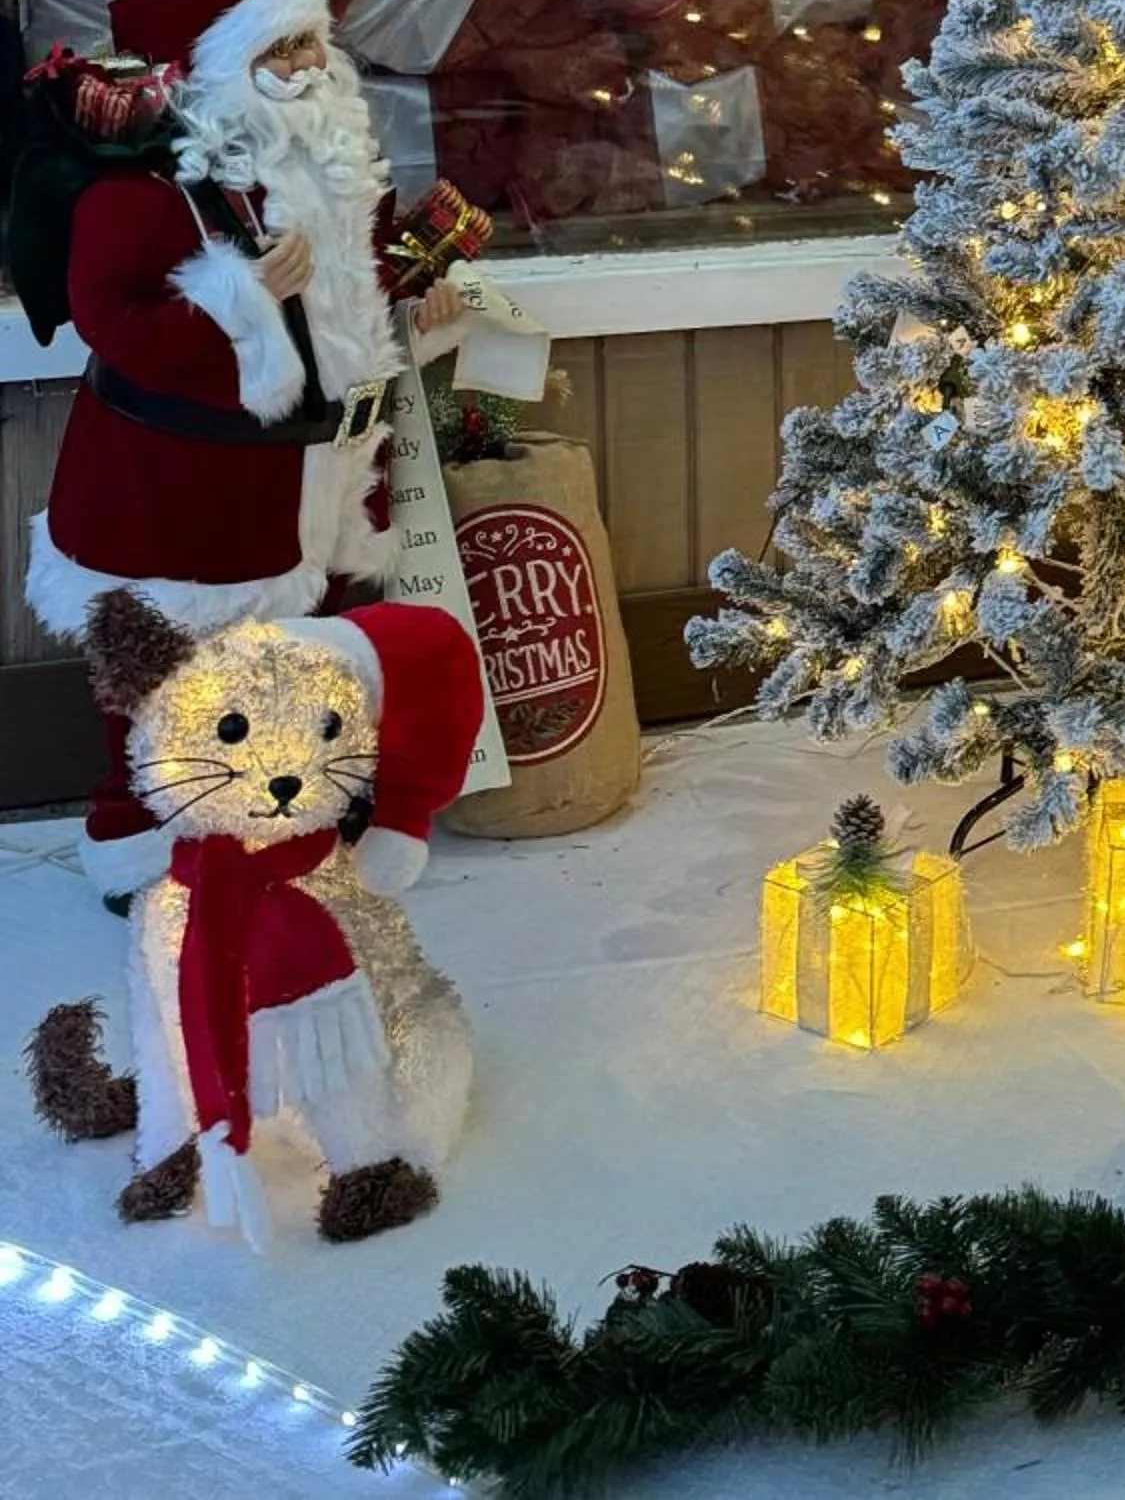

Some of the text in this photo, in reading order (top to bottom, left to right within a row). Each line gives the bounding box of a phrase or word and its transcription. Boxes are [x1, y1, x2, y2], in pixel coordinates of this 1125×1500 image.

[399, 573, 446, 597] May
[466, 558, 583, 629] ERRY
[483, 628, 592, 693] RISTMAS
